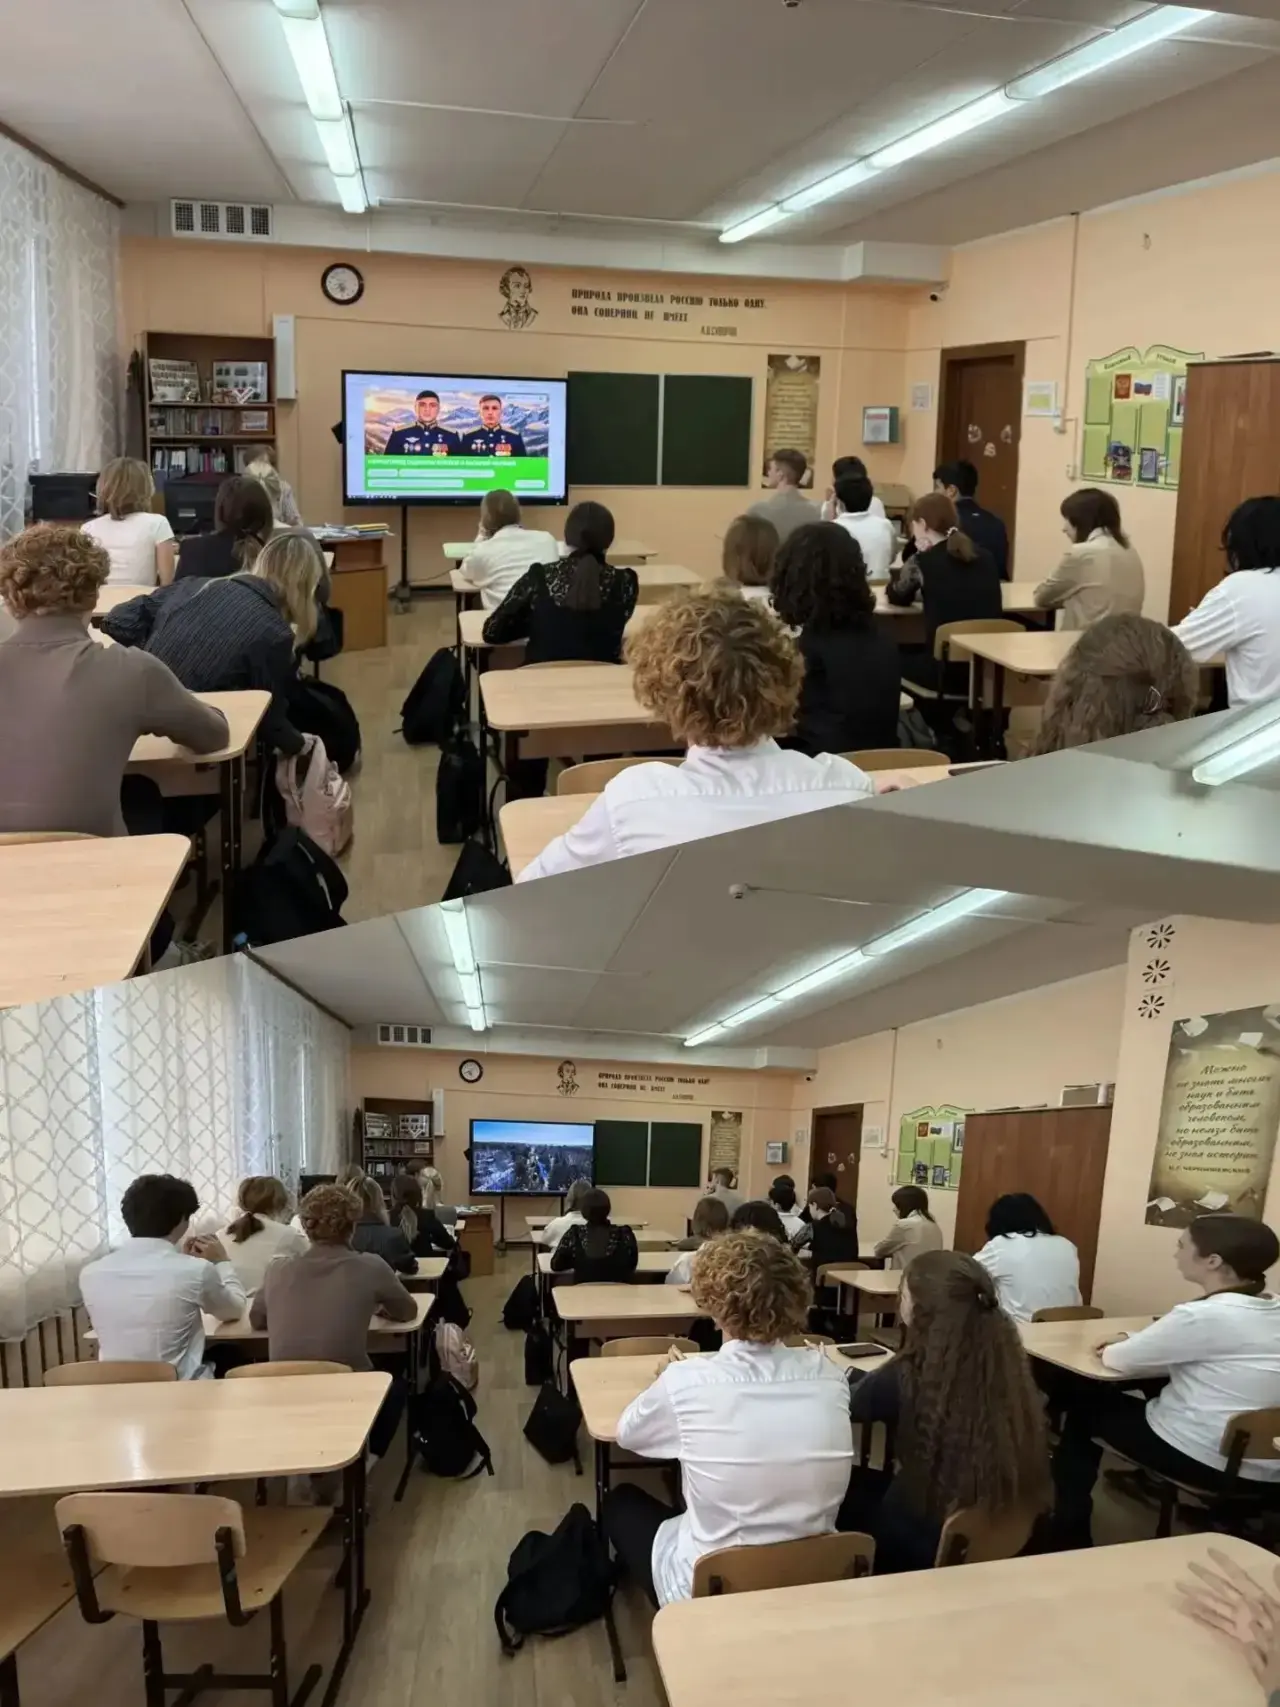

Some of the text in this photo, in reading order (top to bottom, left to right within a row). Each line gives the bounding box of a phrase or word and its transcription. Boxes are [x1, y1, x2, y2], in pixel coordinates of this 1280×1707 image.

[571, 288, 612, 301] ПРИРОДА
[616, 292, 665, 304] ПРОИЗВЕЛА
[669, 294, 703, 306] РОССИЮ
[709, 296, 739, 308] ТОЛЬКО
[571, 305, 588, 316] ОНА
[644, 310, 654, 321] НЕ
[1200, 1064, 1248, 1076] Можно
[1190, 1079, 1225, 1090] знать
[1186, 1086, 1255, 1102] наук и быть
[1178, 1100, 1261, 1113] образованным
[1175, 1124, 1260, 1137] но нельзя быть
[1164, 1150, 1178, 1158] не
[1178, 1150, 1204, 1161] зная
